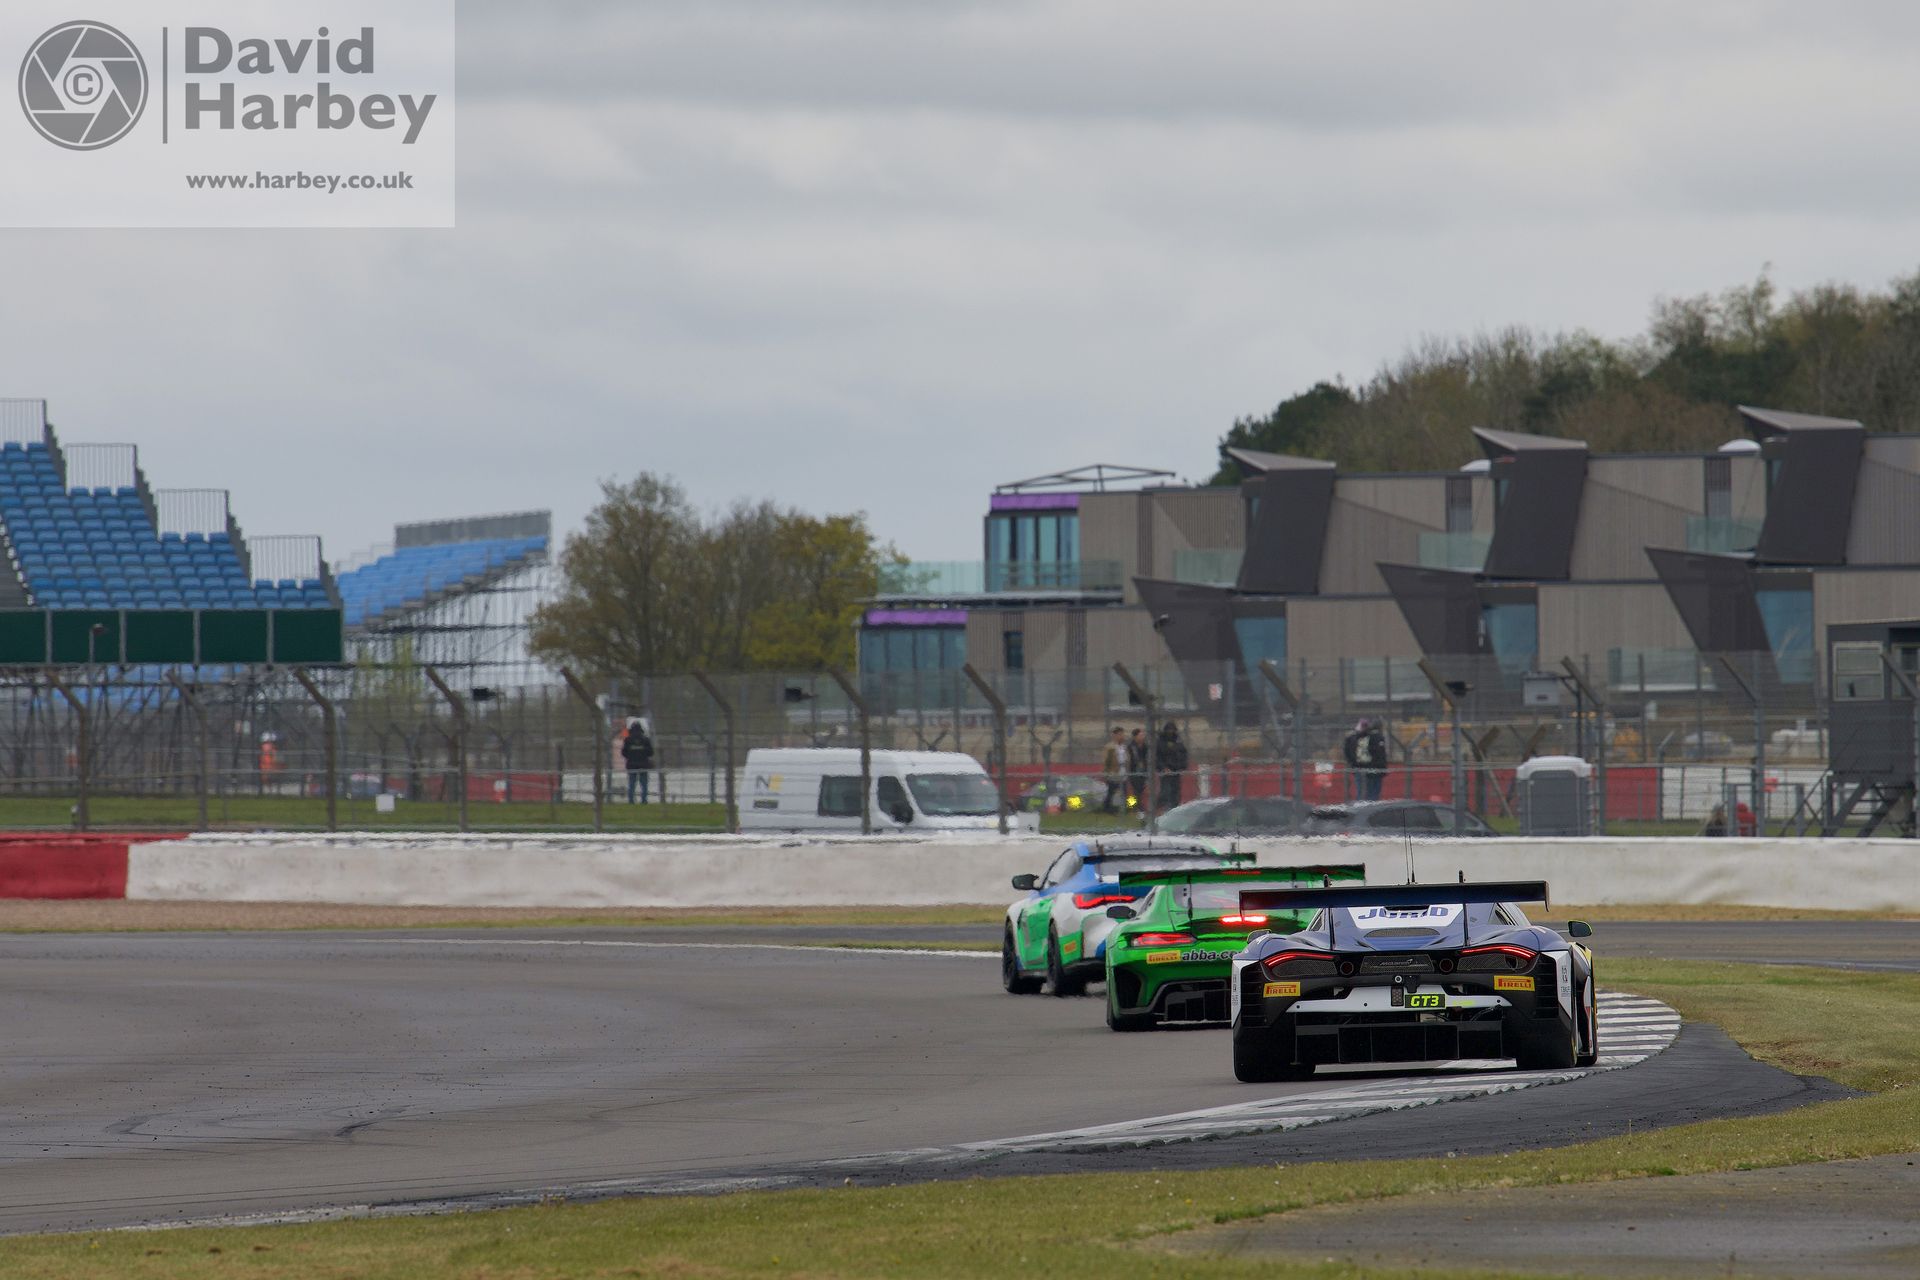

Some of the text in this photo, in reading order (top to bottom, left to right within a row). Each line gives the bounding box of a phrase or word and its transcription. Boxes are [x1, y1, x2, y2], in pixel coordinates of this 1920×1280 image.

[1497, 977, 1532, 989] PIRELLI
[1265, 984, 1297, 995] PIRELLI
[1410, 995, 1440, 1008] GT3
